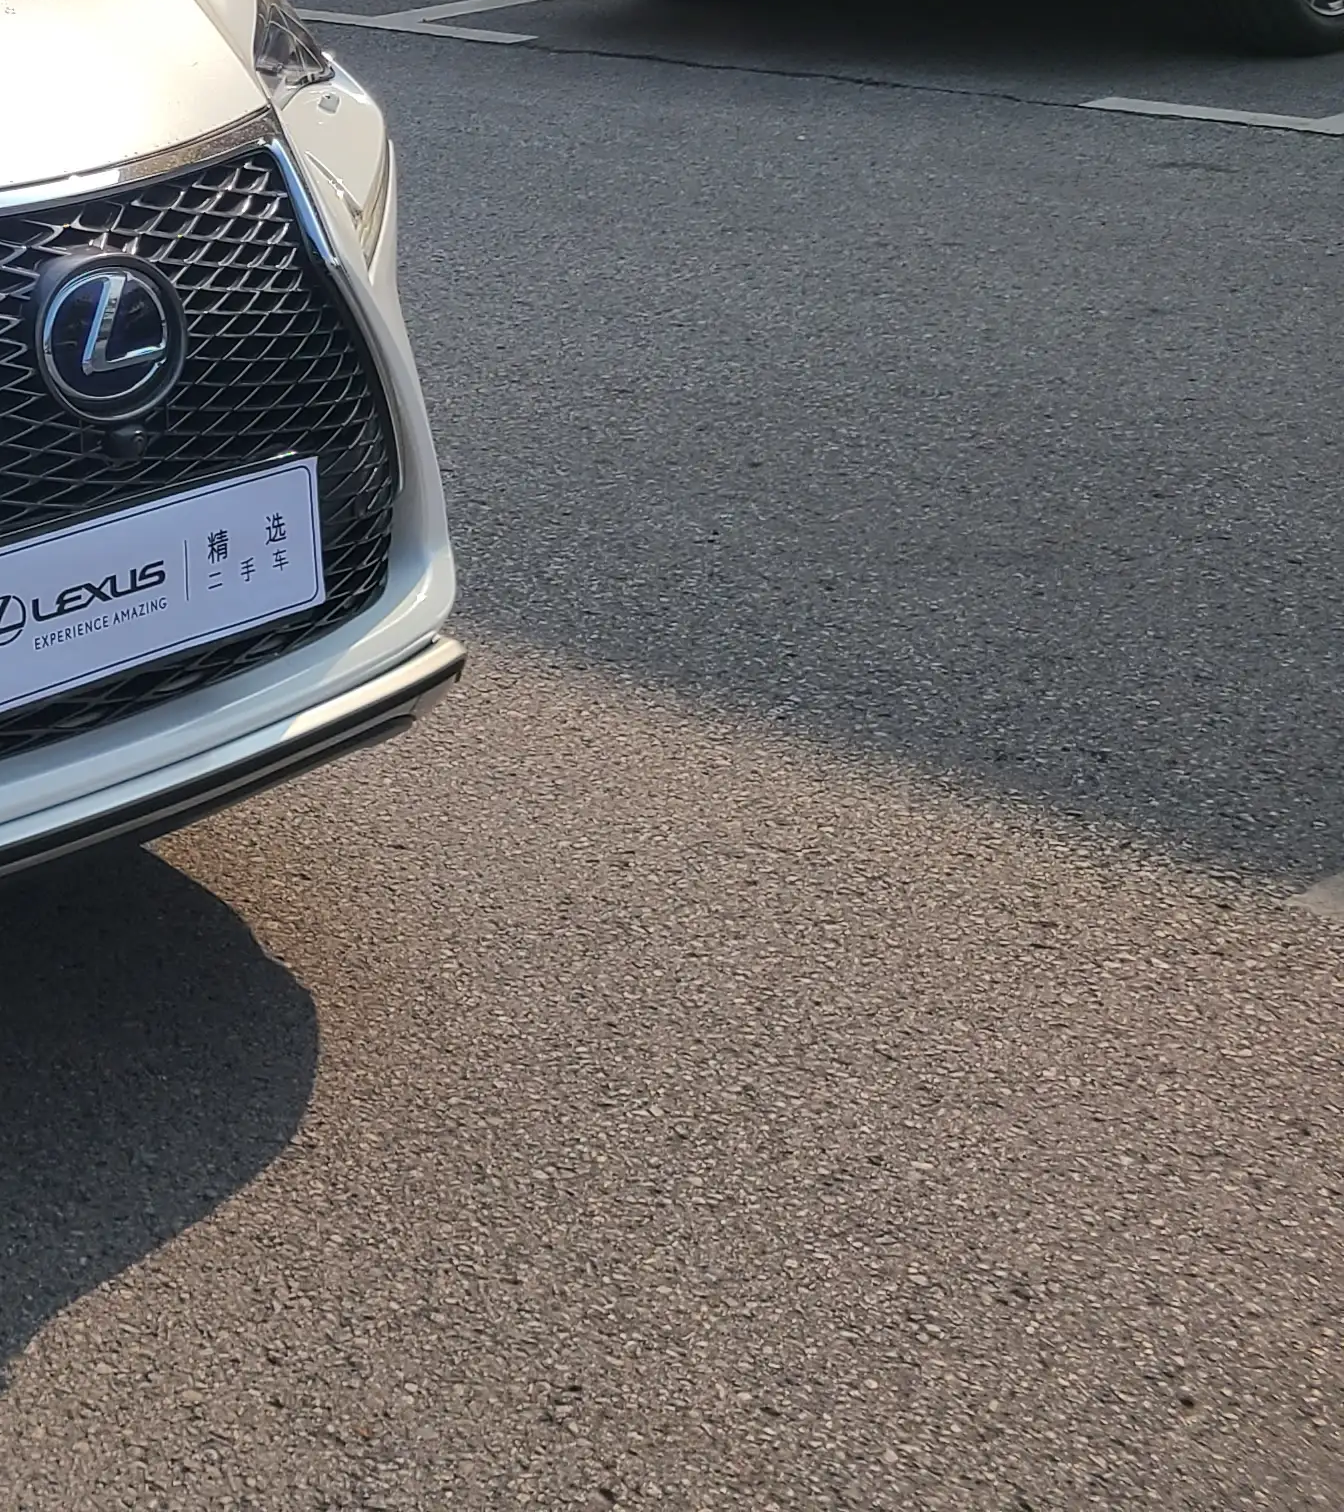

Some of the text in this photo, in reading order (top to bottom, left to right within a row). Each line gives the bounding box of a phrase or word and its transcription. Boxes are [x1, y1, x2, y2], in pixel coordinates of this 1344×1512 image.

[207, 512, 287, 564] 精选
[31, 560, 166, 622] LEXUS
[208, 549, 289, 590] 二手车
[34, 597, 168, 651] EXPERIENCE AMAZING
